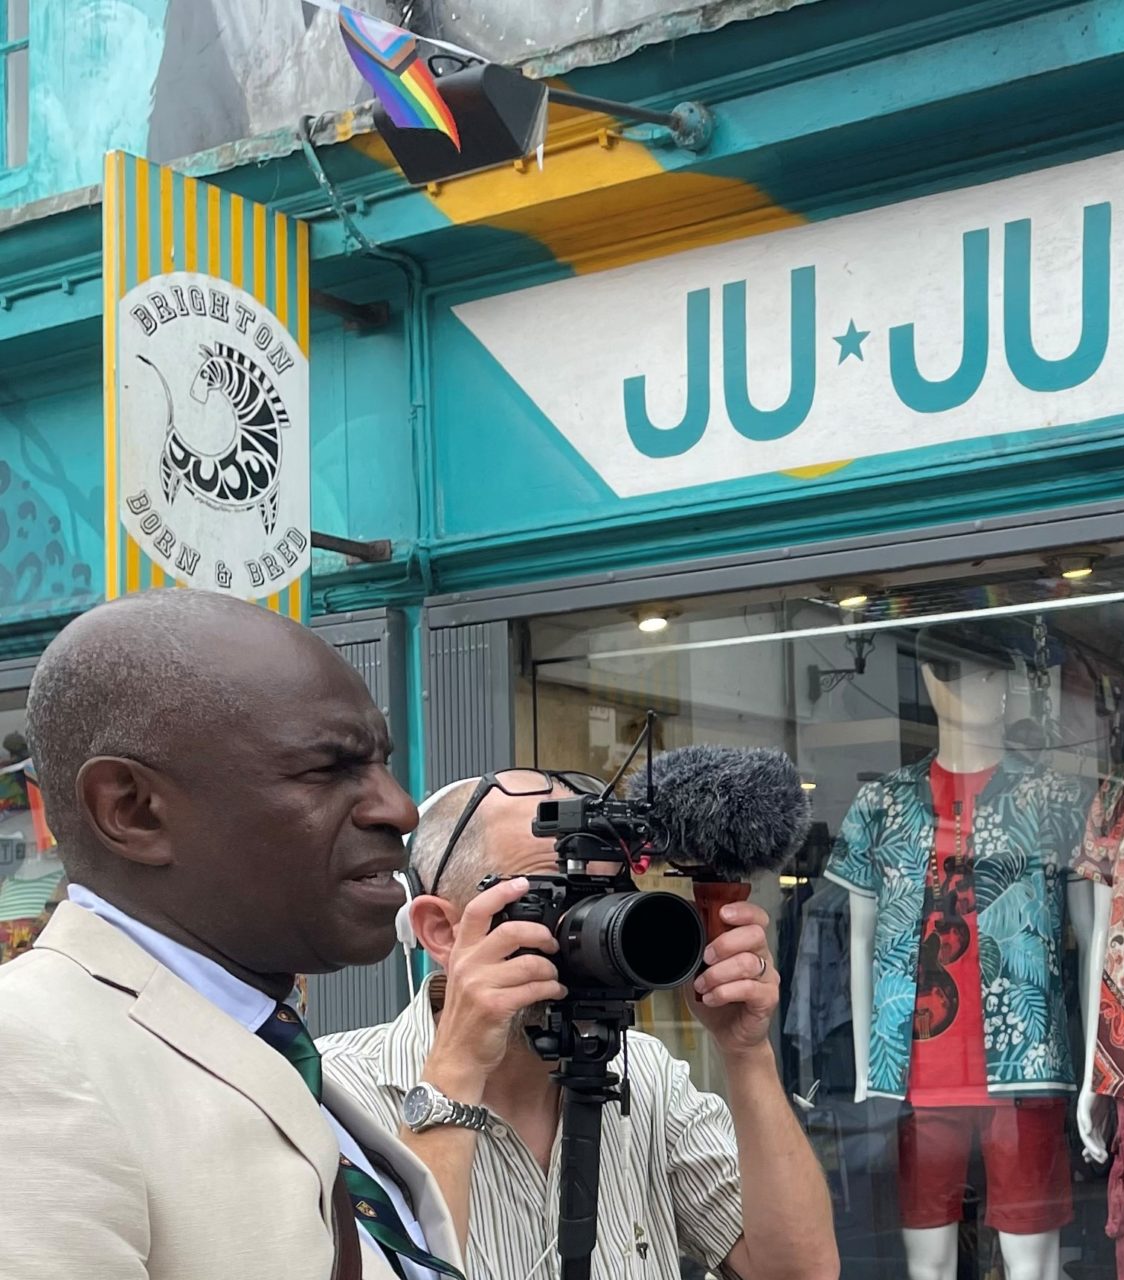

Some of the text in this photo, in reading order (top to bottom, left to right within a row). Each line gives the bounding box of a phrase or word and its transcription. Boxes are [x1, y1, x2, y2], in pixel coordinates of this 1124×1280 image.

[130, 285, 294, 375] BRIGHTON
[623, 202, 1112, 458] JU JU
[126, 490, 307, 588] BORN & BRED
